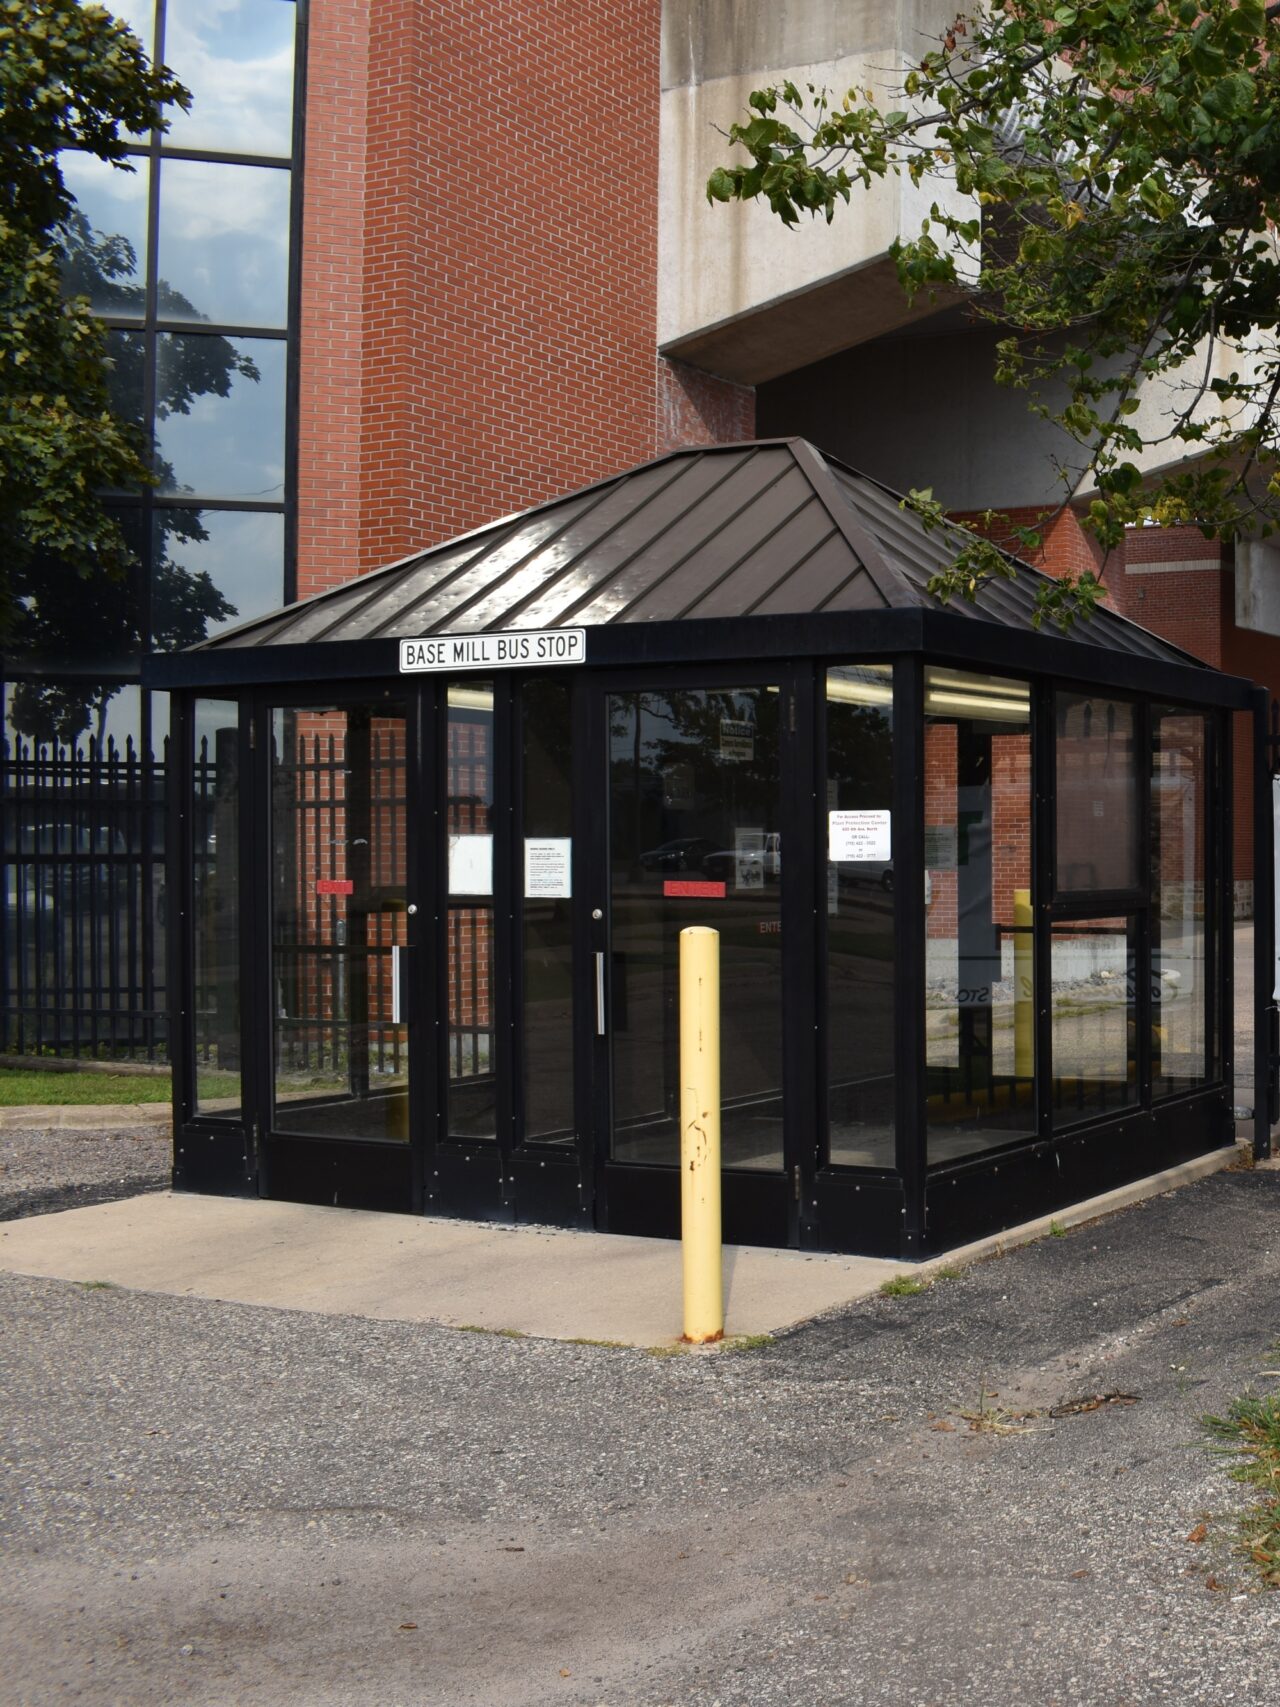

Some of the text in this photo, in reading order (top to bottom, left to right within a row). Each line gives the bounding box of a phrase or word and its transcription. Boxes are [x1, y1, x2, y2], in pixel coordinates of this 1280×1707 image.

[407, 635, 578, 665] BASE MILL BUS STOP
[669, 881, 721, 896] ENTER
